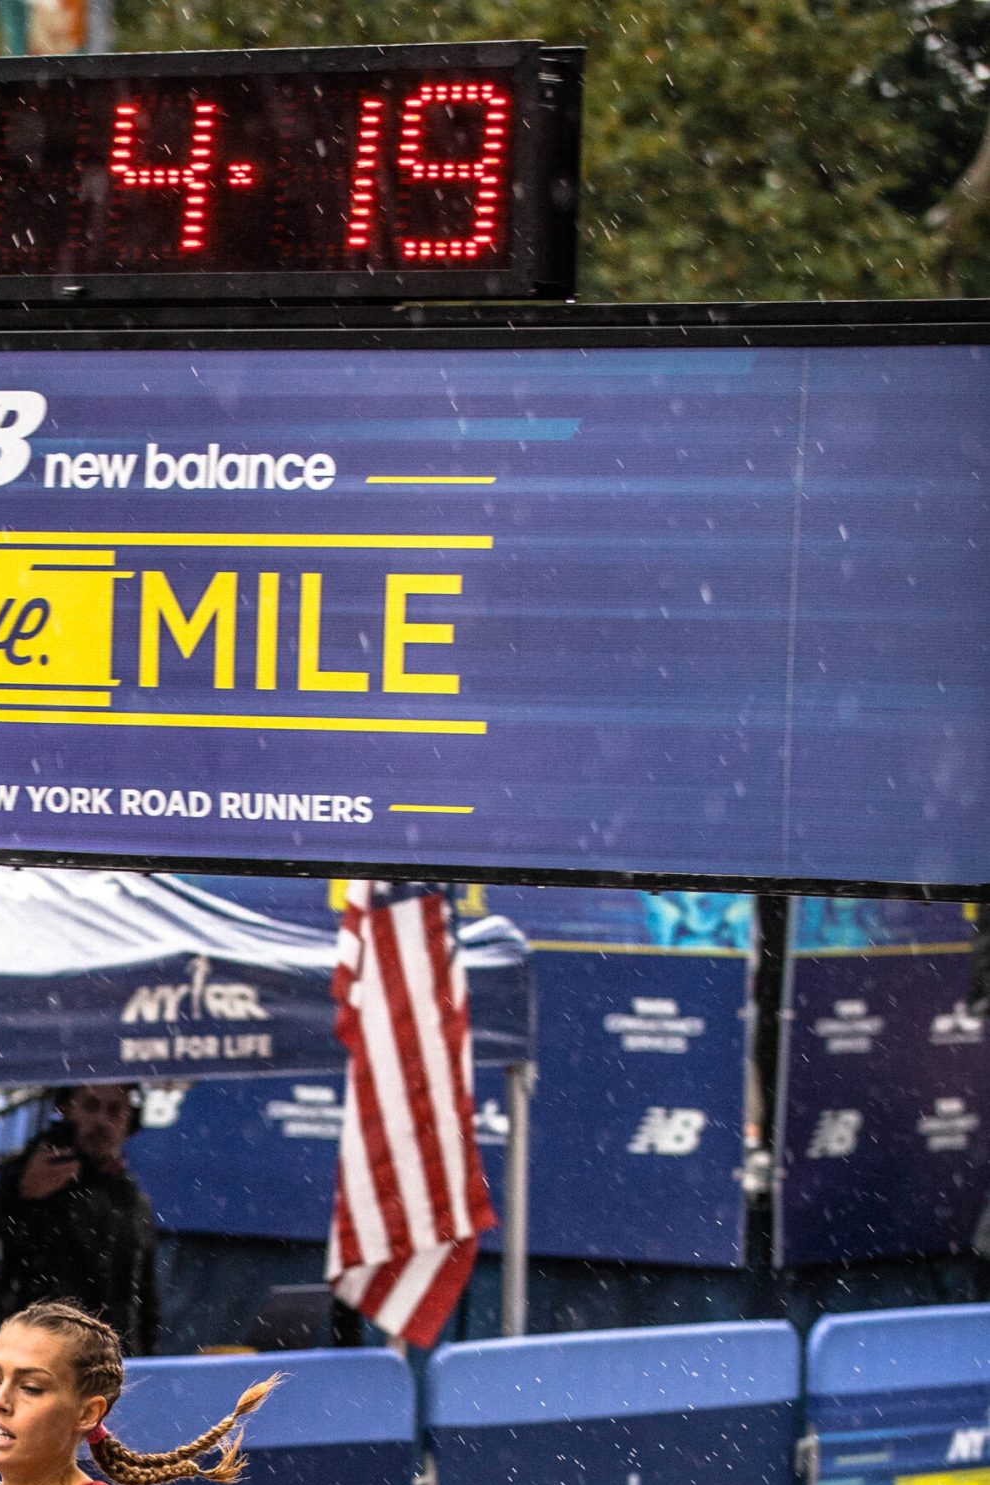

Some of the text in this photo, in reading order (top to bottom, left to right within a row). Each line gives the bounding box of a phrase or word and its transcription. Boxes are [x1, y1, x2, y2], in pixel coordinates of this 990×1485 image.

[44, 442, 337, 490] new balance
[138, 571, 464, 695] MILE
[26, 785, 114, 815] YORK
[120, 790, 212, 818] ROAD
[220, 793, 374, 824] RUNNERS
